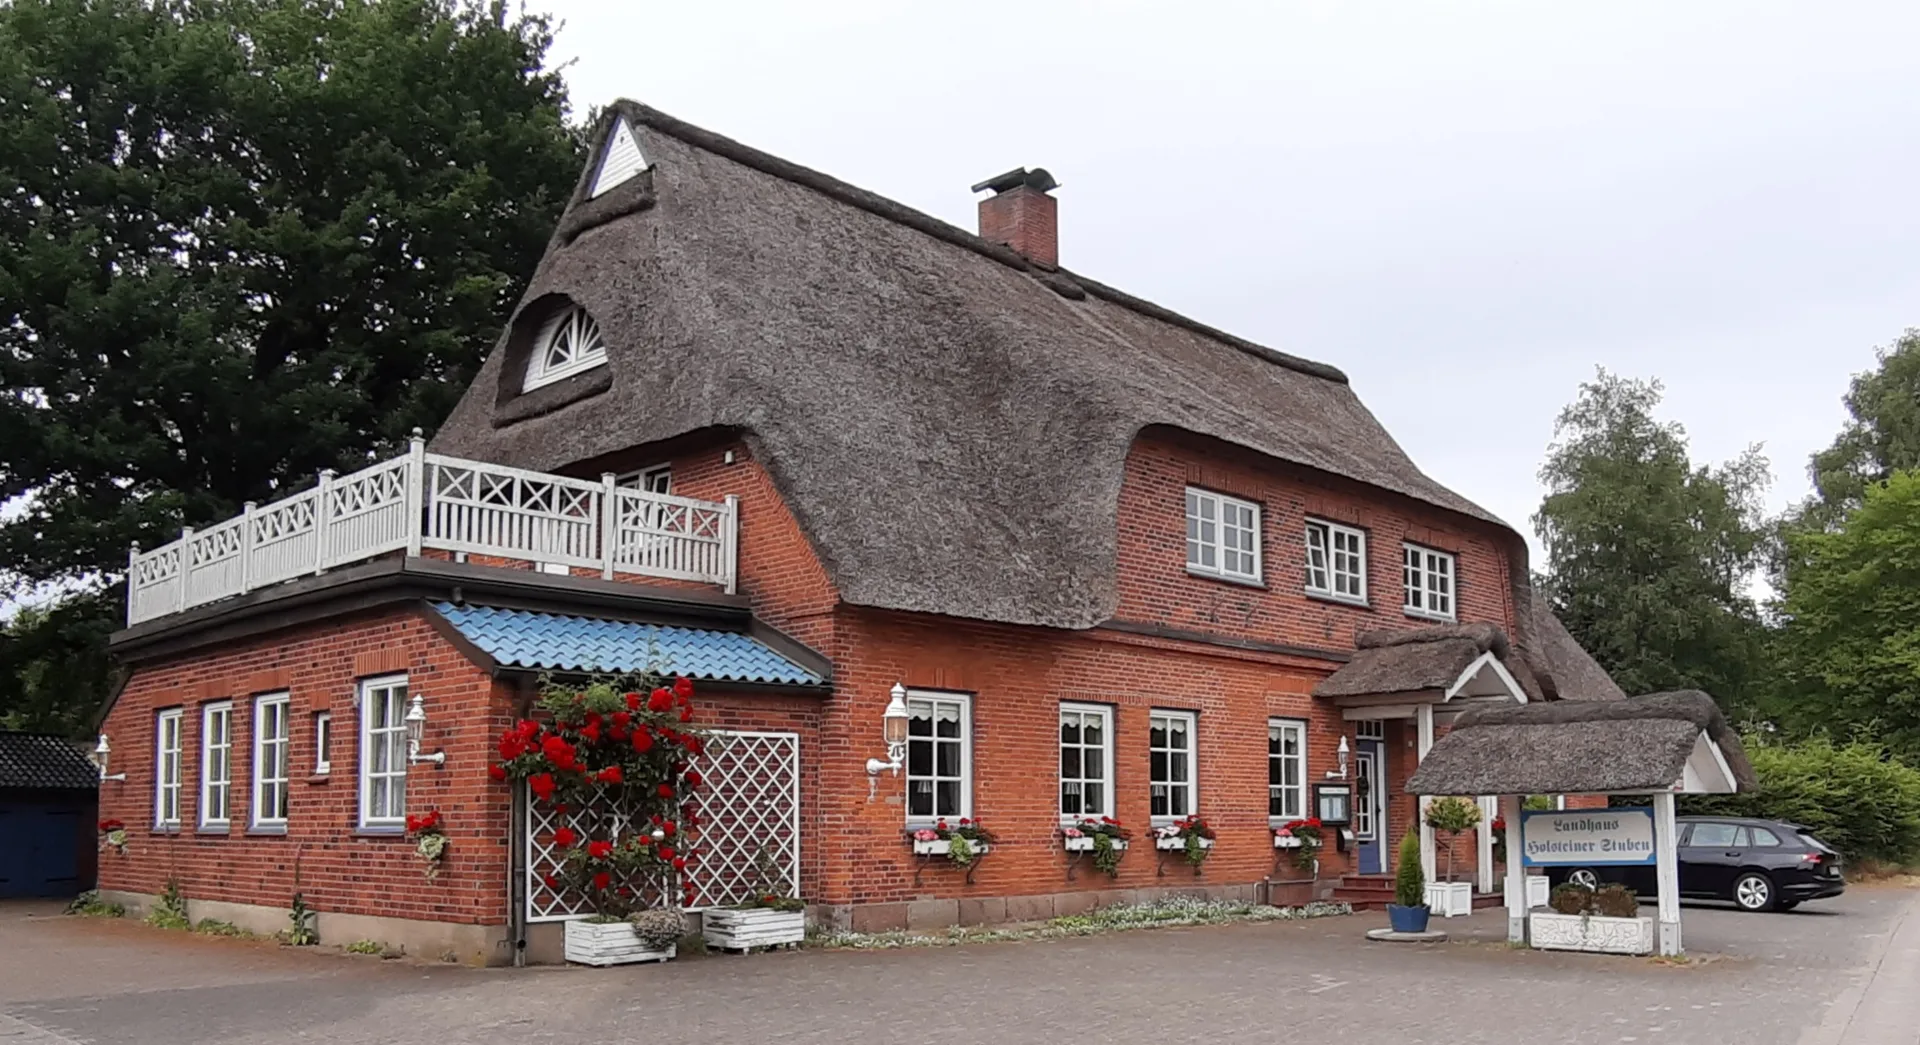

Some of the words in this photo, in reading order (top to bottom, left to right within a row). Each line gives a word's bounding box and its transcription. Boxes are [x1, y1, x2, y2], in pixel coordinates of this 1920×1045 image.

[1554, 818, 1620, 833] Landhaus
[1527, 840, 1595, 855] Holsteiner
[1600, 838, 1650, 852] Stuben
